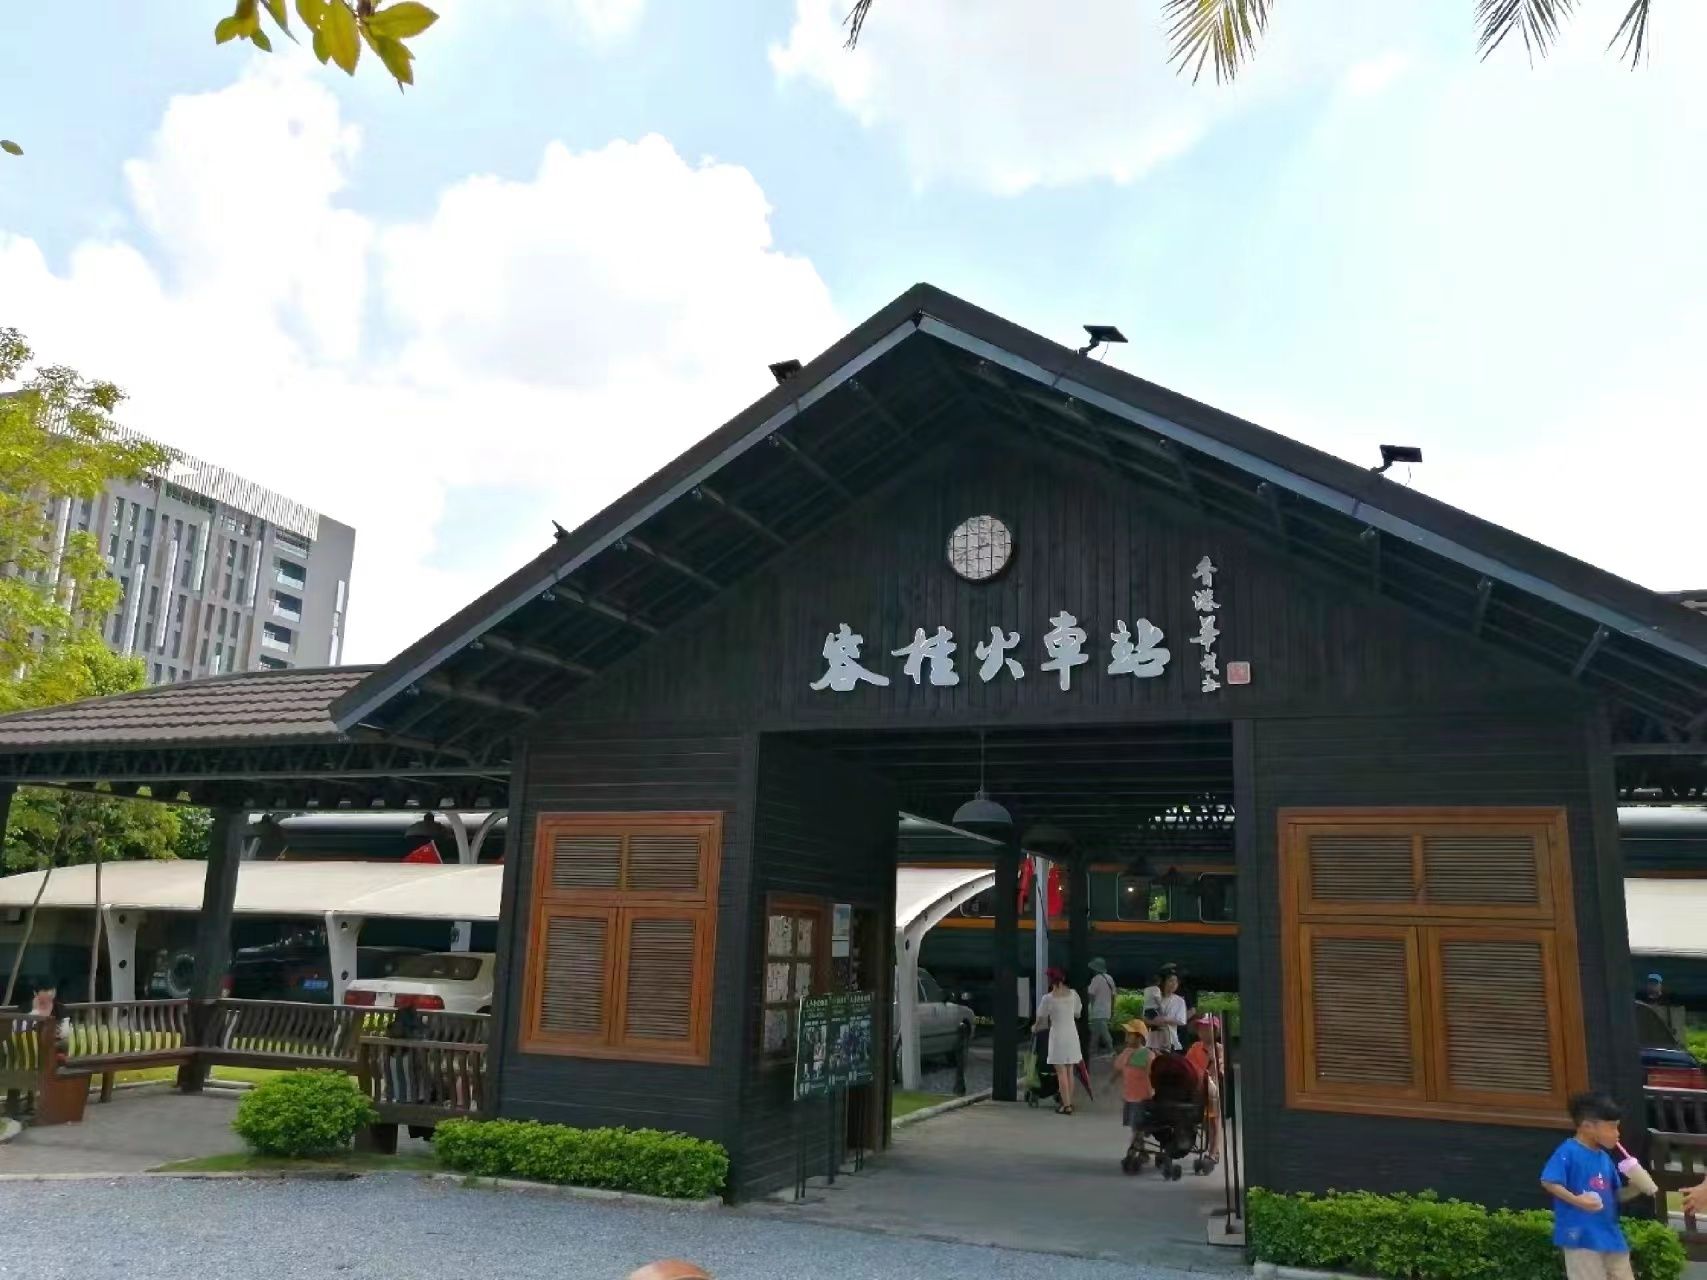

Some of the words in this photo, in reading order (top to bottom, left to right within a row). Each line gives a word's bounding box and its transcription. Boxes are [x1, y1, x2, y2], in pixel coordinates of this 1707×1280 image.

[809, 610, 1171, 691] 容桂火車站
